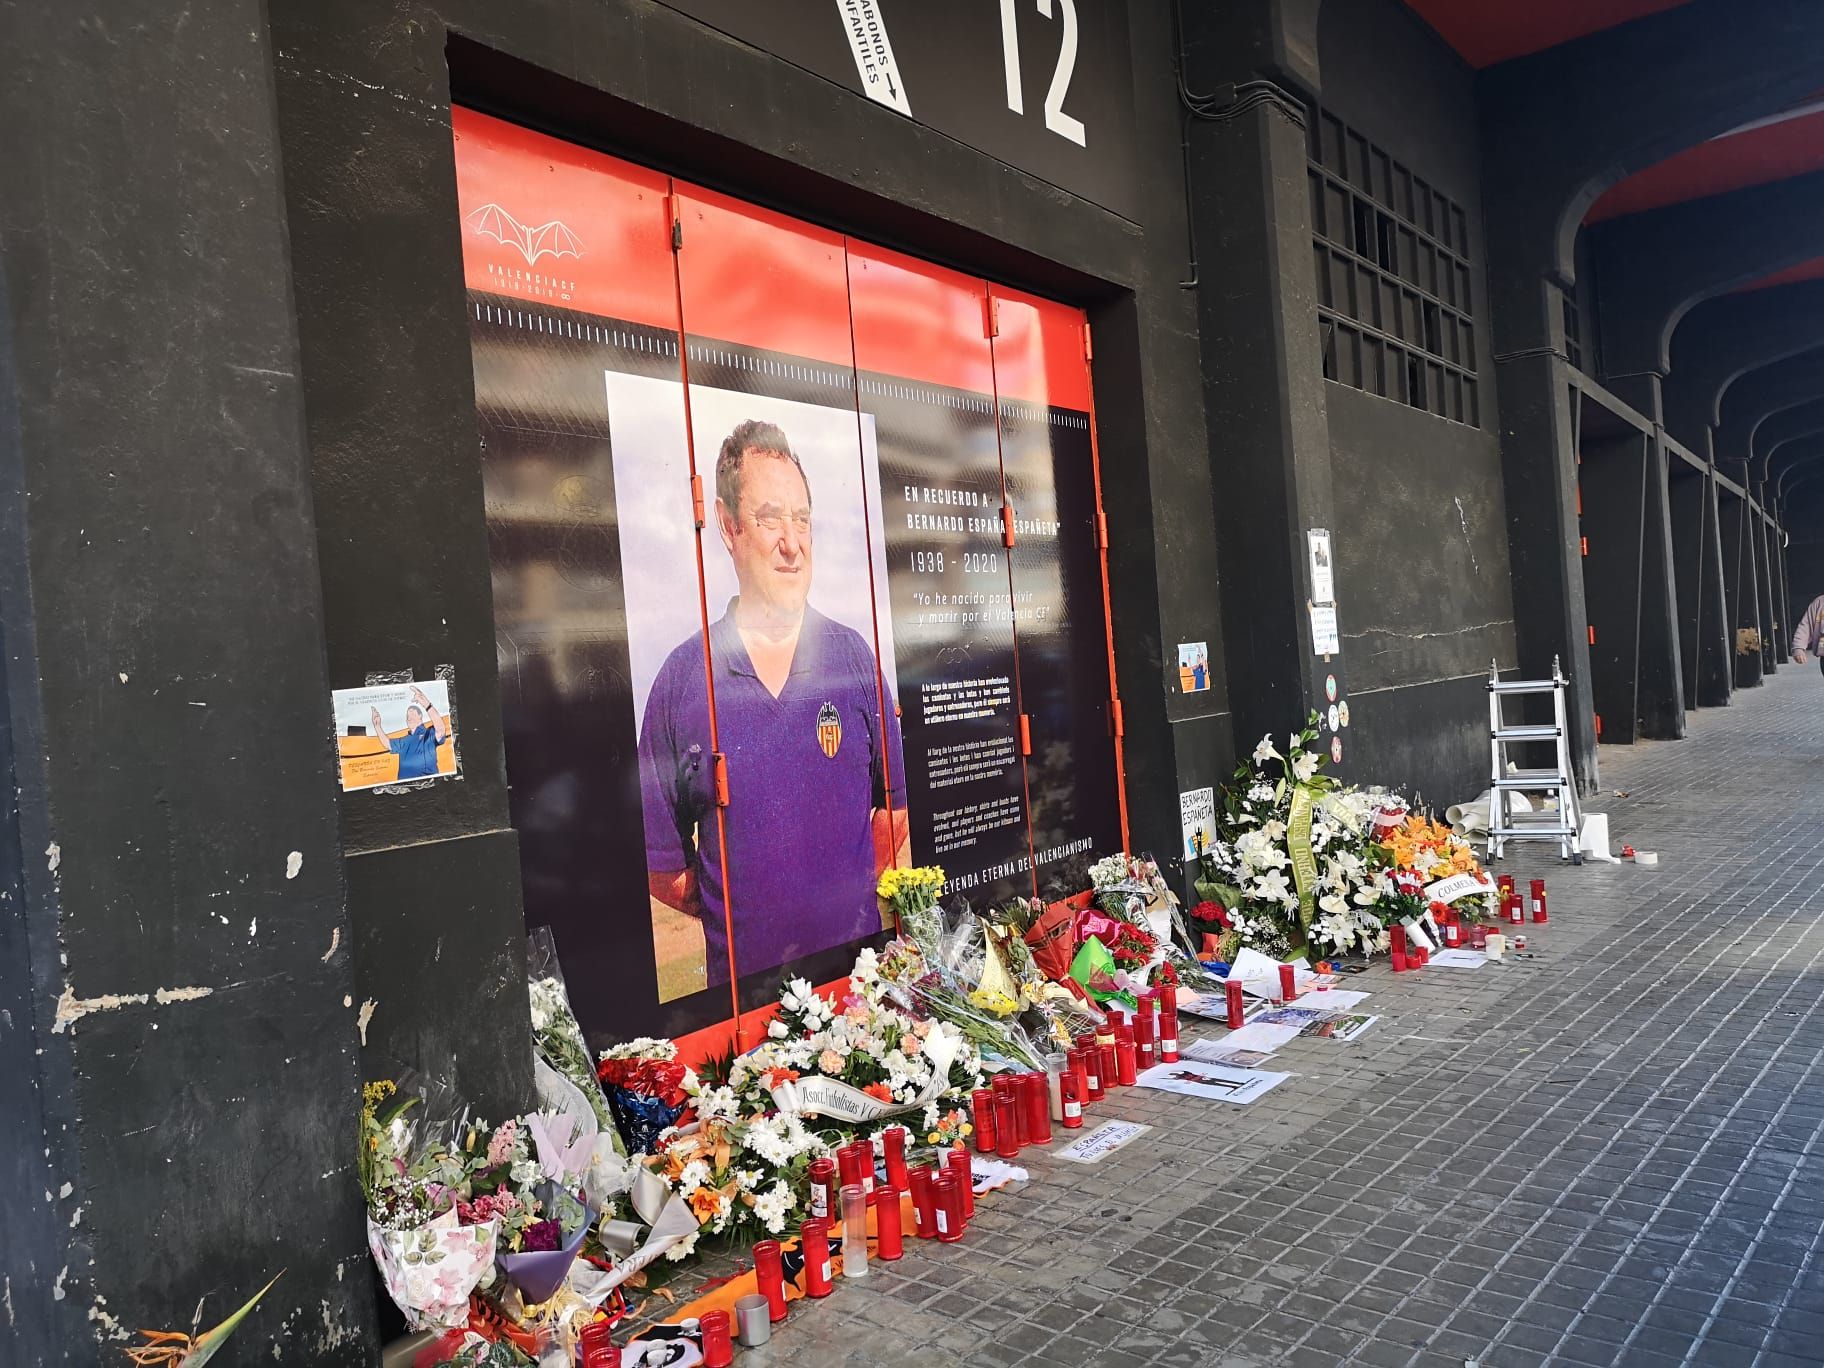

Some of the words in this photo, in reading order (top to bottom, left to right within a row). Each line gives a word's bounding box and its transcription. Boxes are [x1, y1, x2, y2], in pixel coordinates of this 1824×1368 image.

[905, 486, 919, 502] EN
[924, 487, 978, 507] RECUERDO
[982, 492, 989, 507] A
[907, 513, 964, 531] BERNARDO
[968, 514, 1005, 533] ESPAÑA
[910, 552, 944, 573] 1938
[964, 552, 998, 573] 2020
[935, 592, 947, 605] he
[952, 591, 985, 604] nacido
[918, 612, 924, 626] y
[929, 609, 958, 623] morir
[962, 611, 979, 625] por
[984, 609, 992, 621] el
[1181, 789, 1212, 808] BERNARDO
[941, 872, 979, 897] EYENDA
[982, 861, 1015, 883] ETERNA
[1034, 837, 1093, 866] VALENCIANISMO
